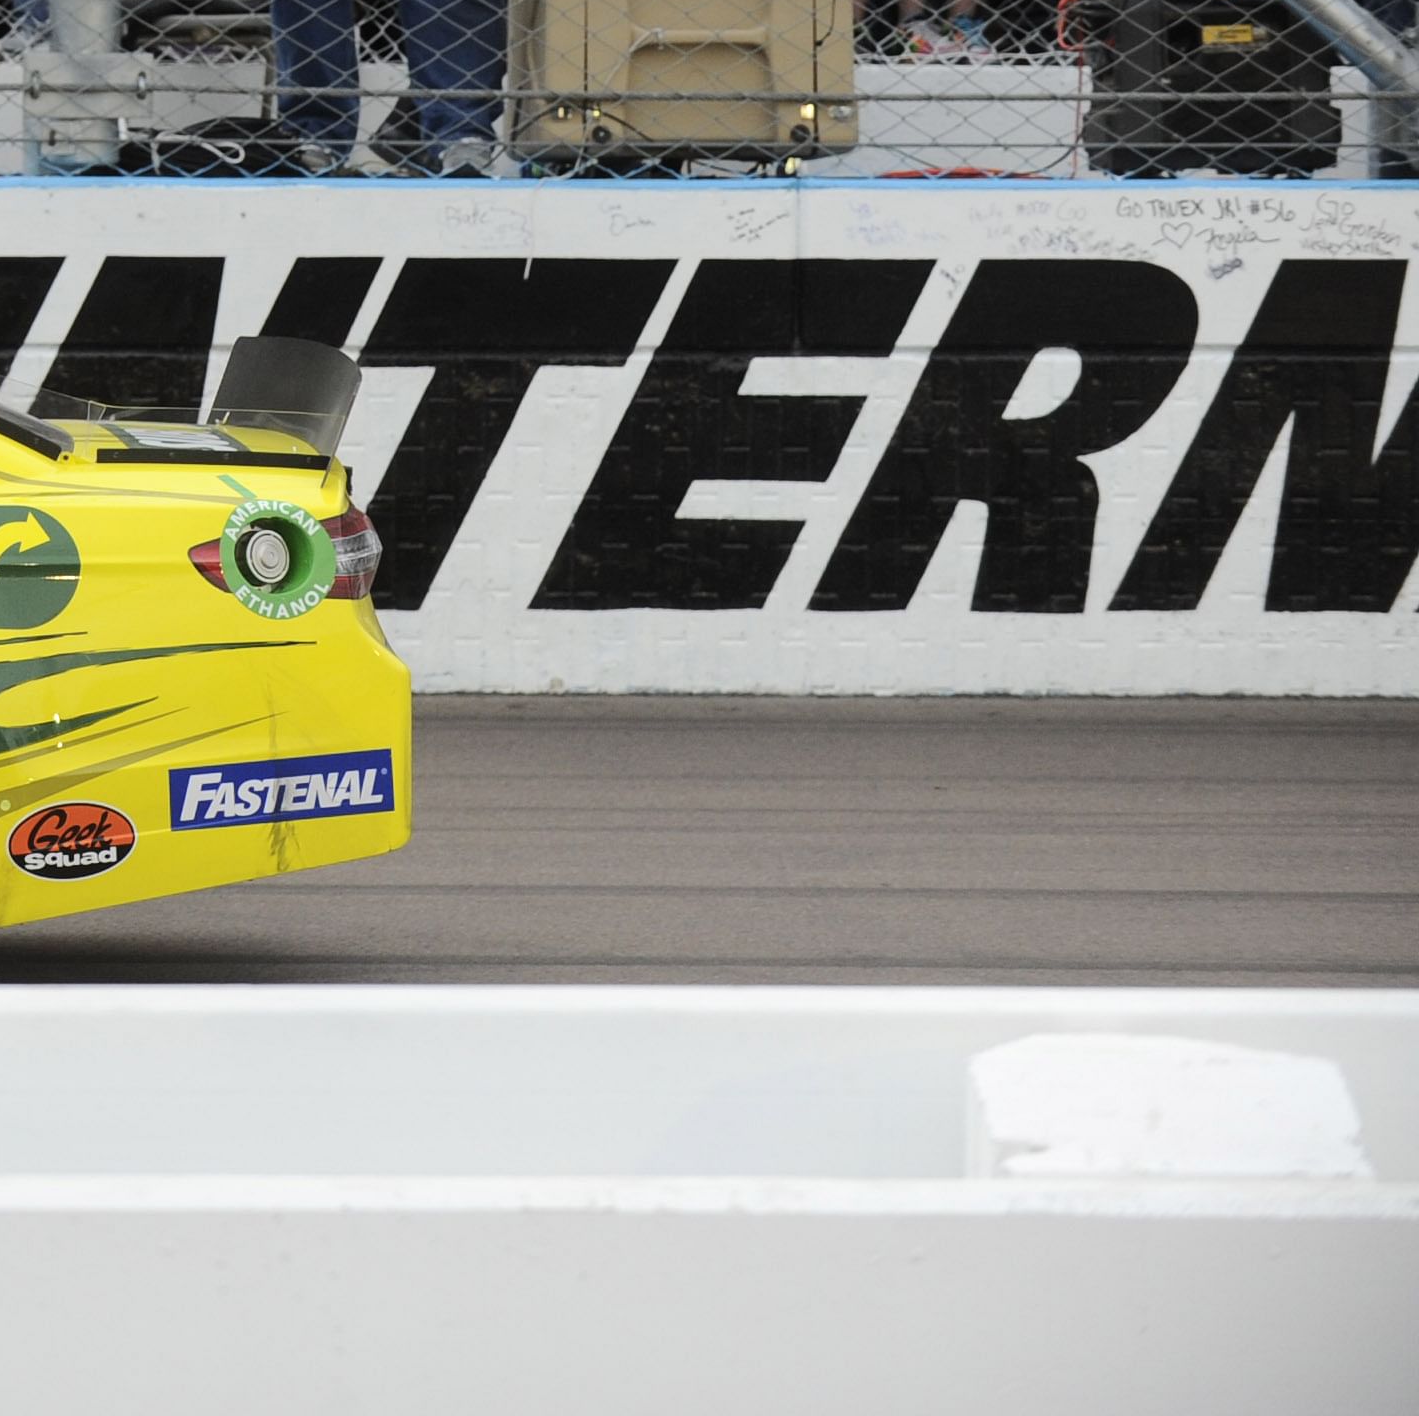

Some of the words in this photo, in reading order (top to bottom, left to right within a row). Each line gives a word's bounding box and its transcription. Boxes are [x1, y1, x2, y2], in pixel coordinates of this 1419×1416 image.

[225, 500, 319, 539] AMERICAN
[234, 582, 330, 620] ETHANOL
[180, 768, 384, 822] FASTENAL
[27, 809, 114, 852] Geek
[24, 845, 119, 872] Squad
